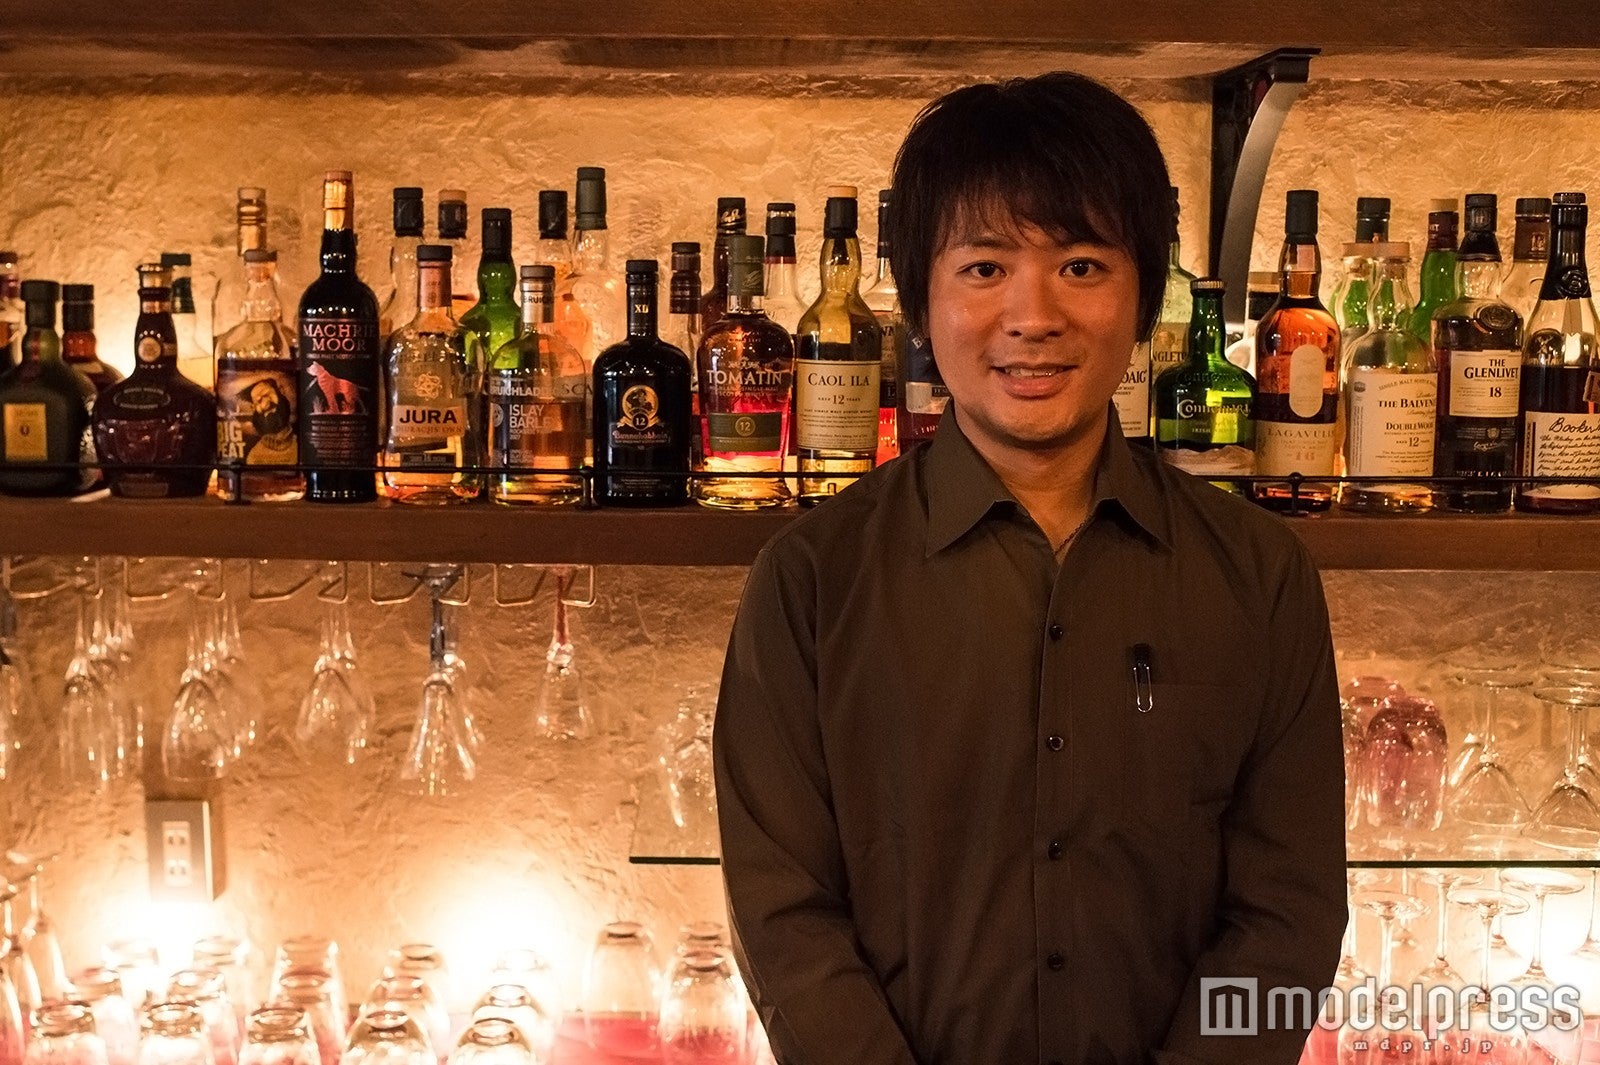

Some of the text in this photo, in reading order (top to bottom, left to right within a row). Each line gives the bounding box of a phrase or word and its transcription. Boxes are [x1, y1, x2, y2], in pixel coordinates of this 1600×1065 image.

[312, 338, 367, 351] MOOR
[1489, 359, 1506, 367] THE
[706, 369, 782, 385] TOMATIN
[1464, 367, 1519, 378] GLENLIVET
[808, 373, 870, 386] CAOL ILA
[1490, 387, 1502, 398] 18
[833, 395, 845, 404] 12
[1379, 398, 1434, 408] THE BALVEN
[509, 404, 544, 416] ISLAY
[399, 409, 457, 424] JURA
[635, 418, 646, 426] 12
[217, 421, 243, 442] BIG
[740, 422, 751, 431] 12
[1409, 437, 1420, 447] 12
[217, 442, 246, 458] PEAT
